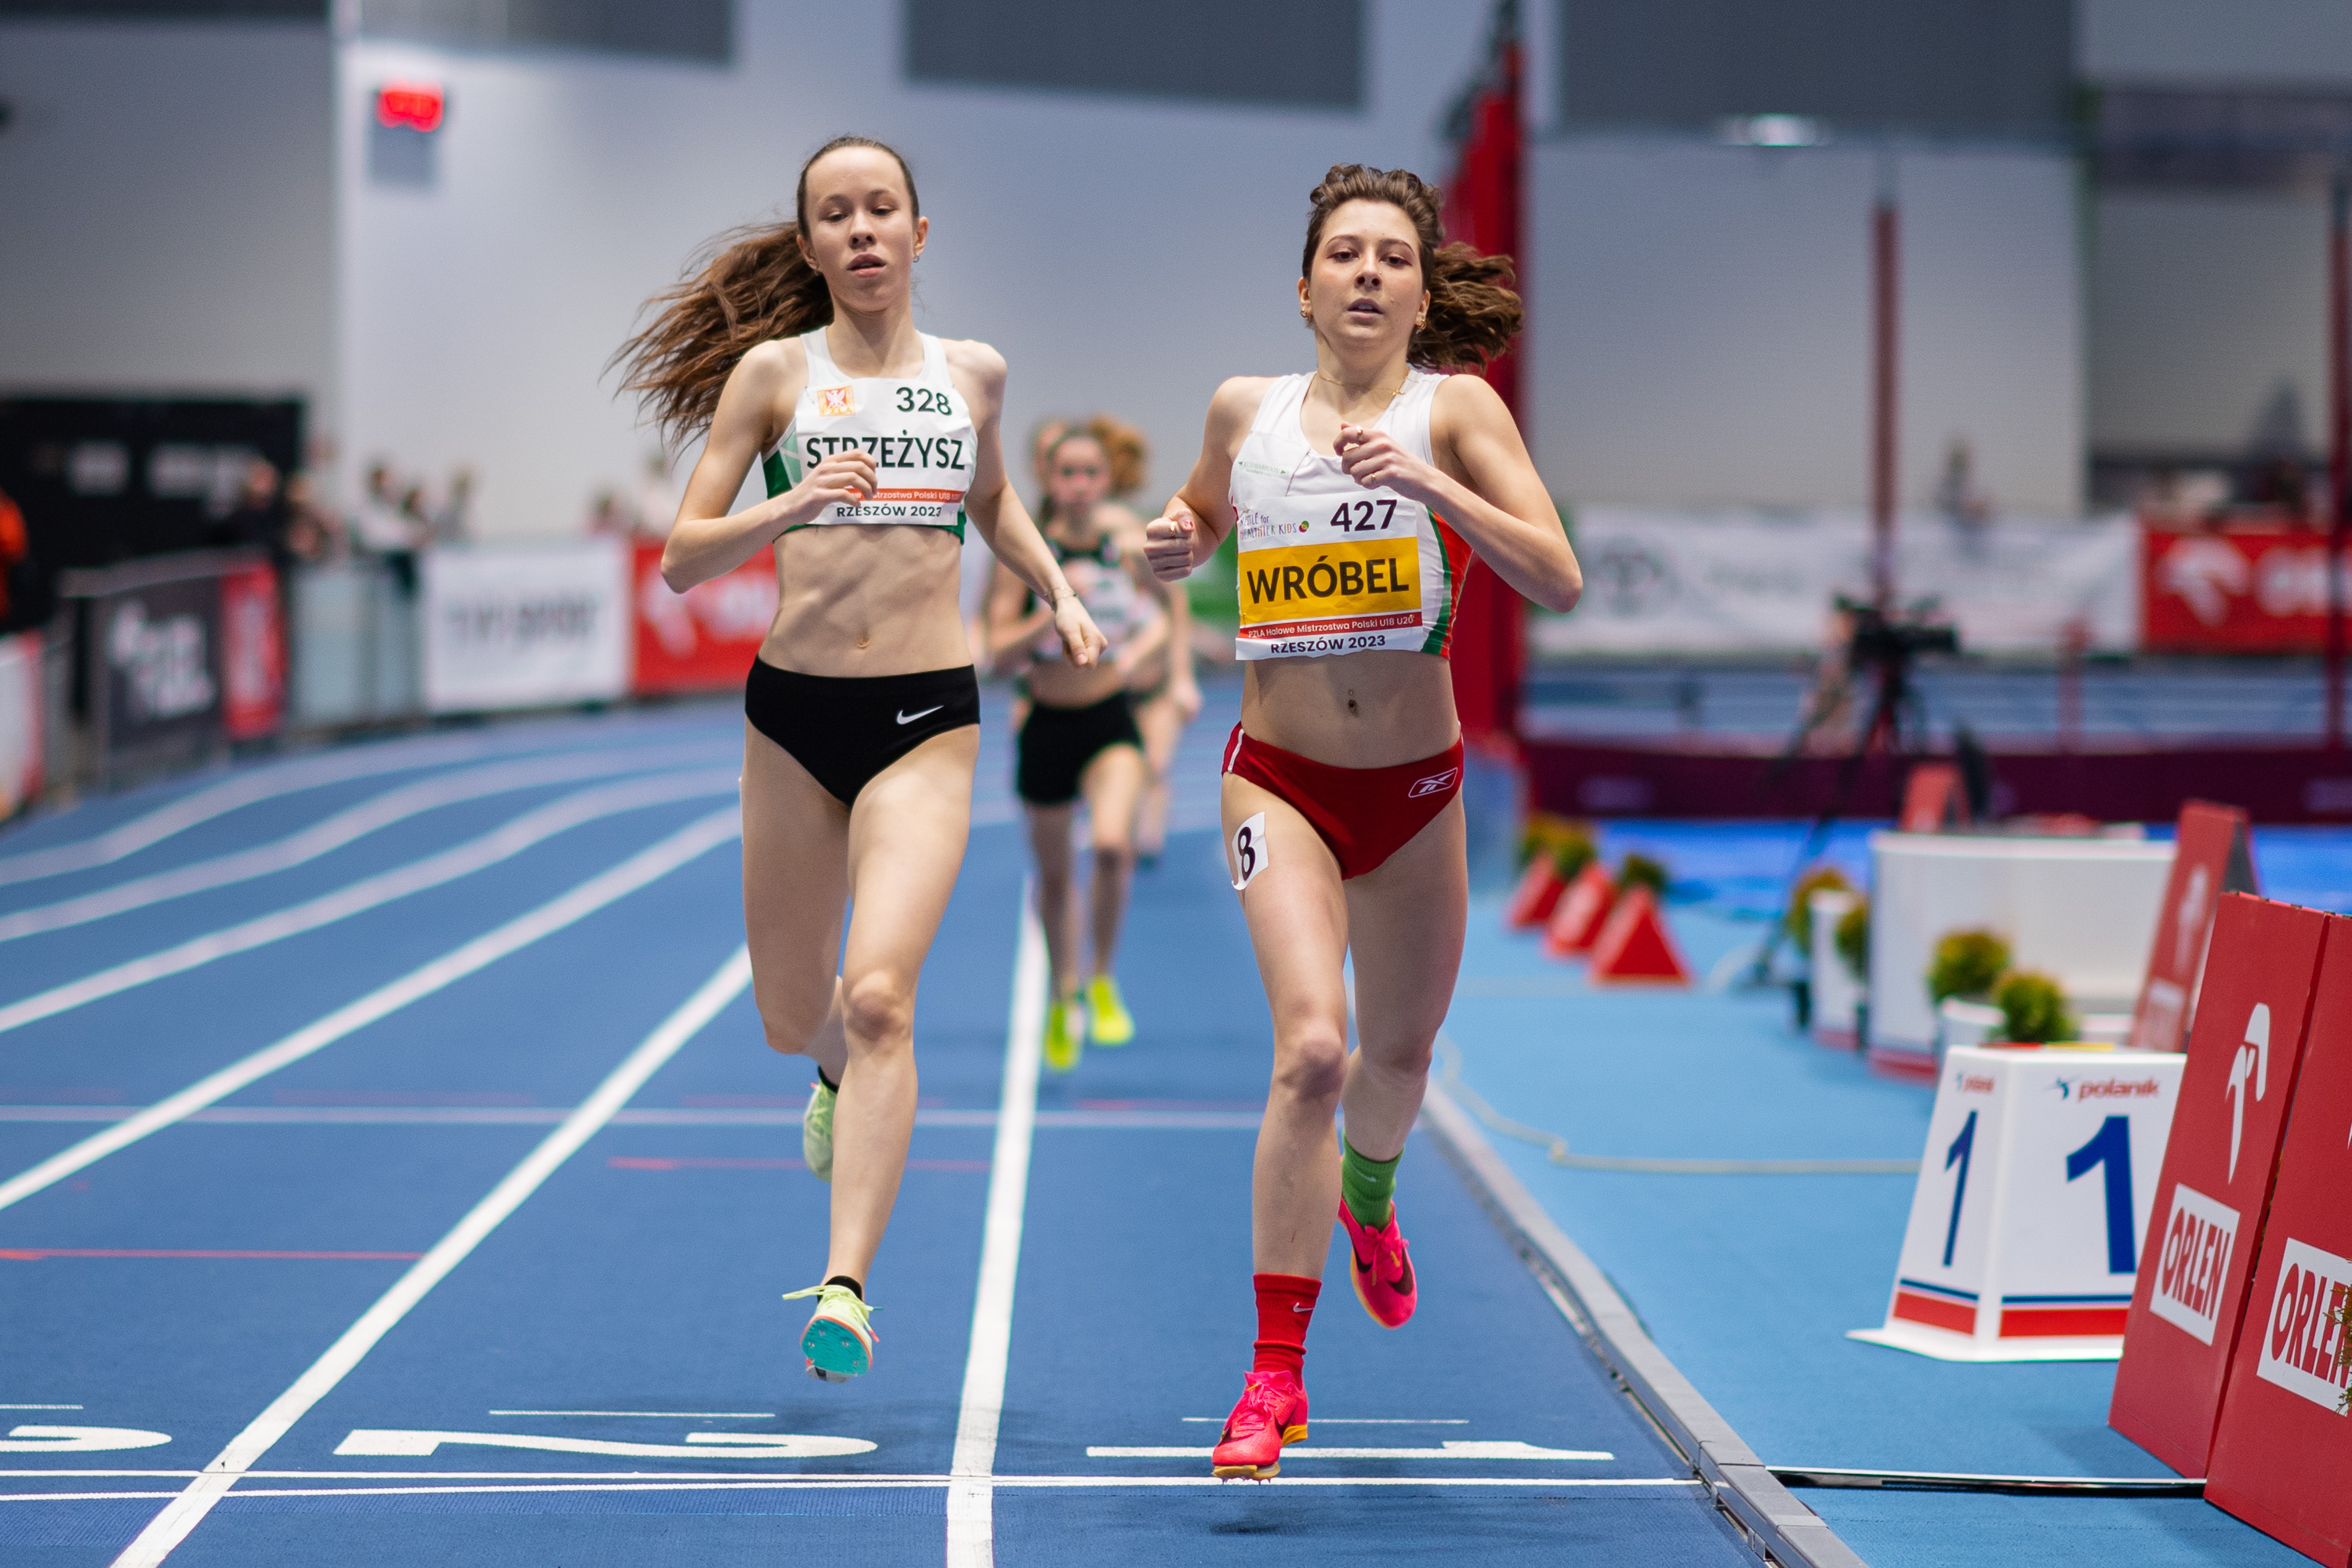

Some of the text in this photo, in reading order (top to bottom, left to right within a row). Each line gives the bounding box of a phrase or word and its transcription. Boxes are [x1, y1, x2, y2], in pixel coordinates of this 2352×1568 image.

[896, 387, 953, 416] 328
[873, 491, 913, 499] strzostwa
[914, 491, 938, 499] Polski
[837, 503, 942, 517] RZESZÓW 2023
[1330, 499, 1398, 532] 427
[1279, 522, 1298, 535] KIDS
[1247, 555, 1410, 604] WRÓBEL
[1248, 615, 1414, 638] PZLA Halowe Mistrzostwa Polski U18 U20
[1271, 635, 1386, 654] RZESZÓW 2023
[1238, 826, 1256, 881] 8
[2078, 1077, 2159, 1101] polanik
[1945, 1110, 1978, 1268] 1
[2066, 1115, 2137, 1275] 1
[2161, 1206, 2230, 1322] ORLEN
